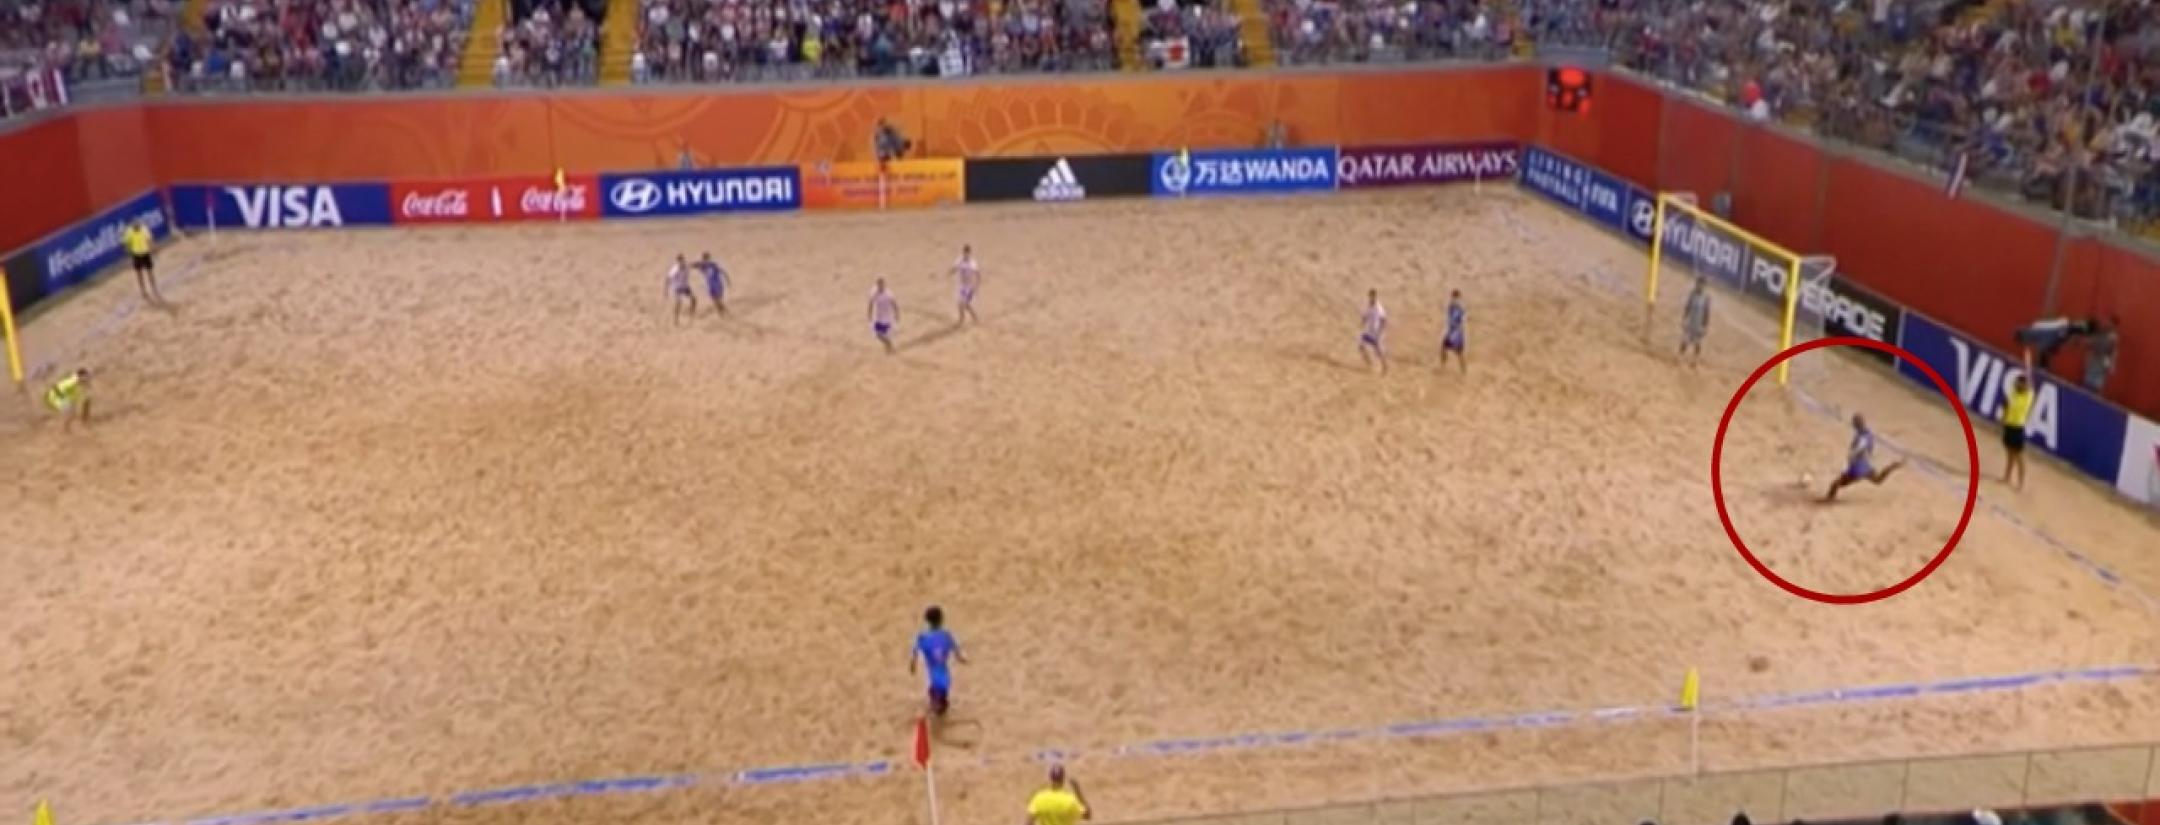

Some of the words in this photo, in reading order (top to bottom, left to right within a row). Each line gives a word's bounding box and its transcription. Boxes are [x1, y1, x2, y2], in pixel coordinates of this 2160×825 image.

[1244, 155, 1329, 182] WANDA
[1337, 153, 1416, 183] QATAR
[1420, 148, 1517, 176] AIRWAYS
[225, 185, 342, 228] VISA
[666, 176, 793, 207] HYUNDAI
[1661, 213, 1740, 275] YUNDAI
